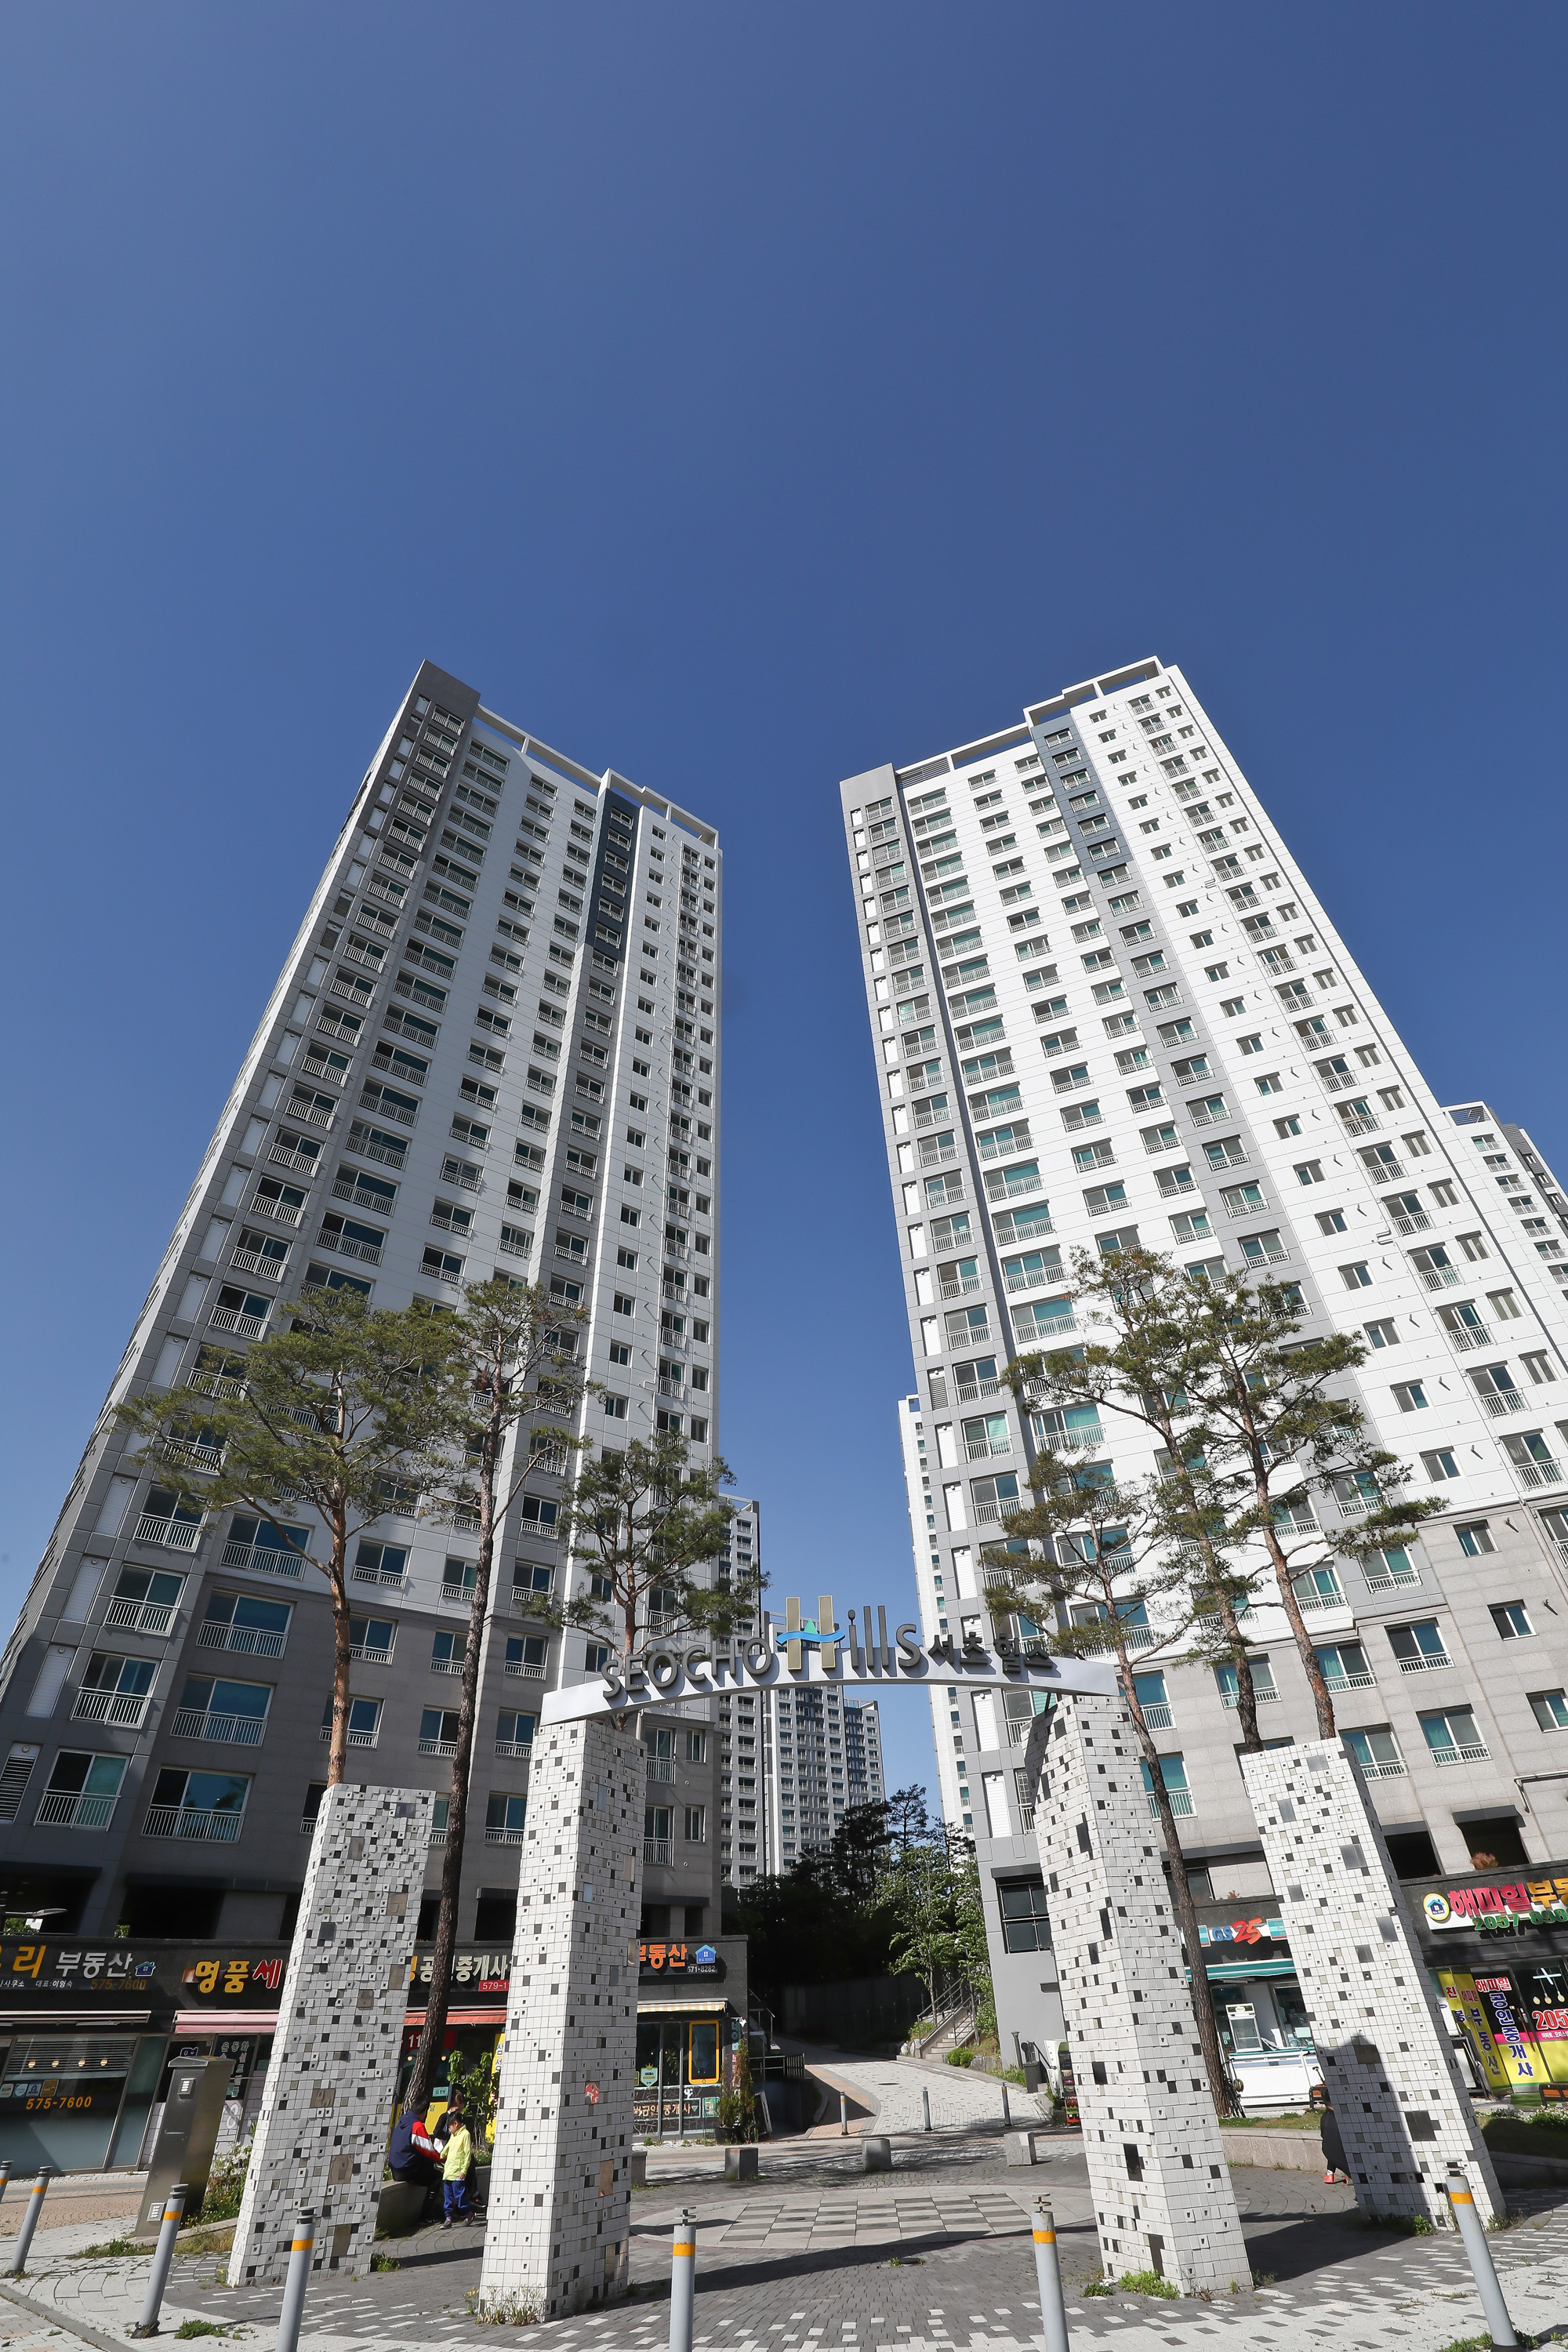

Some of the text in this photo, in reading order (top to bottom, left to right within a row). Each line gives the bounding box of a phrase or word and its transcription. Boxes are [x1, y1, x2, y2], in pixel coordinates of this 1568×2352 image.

[601, 1595, 920, 1698] SEOCHO Hills
[927, 1632, 1054, 1674] 서초힐스
[1212, 1918, 1262, 1944] GS25
[1472, 1907, 1568, 1931] 2057-898
[0, 1944, 132, 1979] 리 부동산
[419, 1955, 508, 1982] 공중개사
[90, 1978, 147, 1990] 575-7600
[194, 1958, 288, 1994] 명품세
[482, 1981, 509, 1990] 579-1
[1475, 1976, 1512, 1992] 해피힐
[1461, 1990, 1479, 2002] 해피힐
[1532, 2009, 1568, 2031] 205
[221, 2041, 249, 2053] 운동화
[1469, 2007, 1501, 2076] 부동산
[1490, 1992, 1534, 2077] 공인중개사
[26, 2096, 93, 2110] 575-7600
